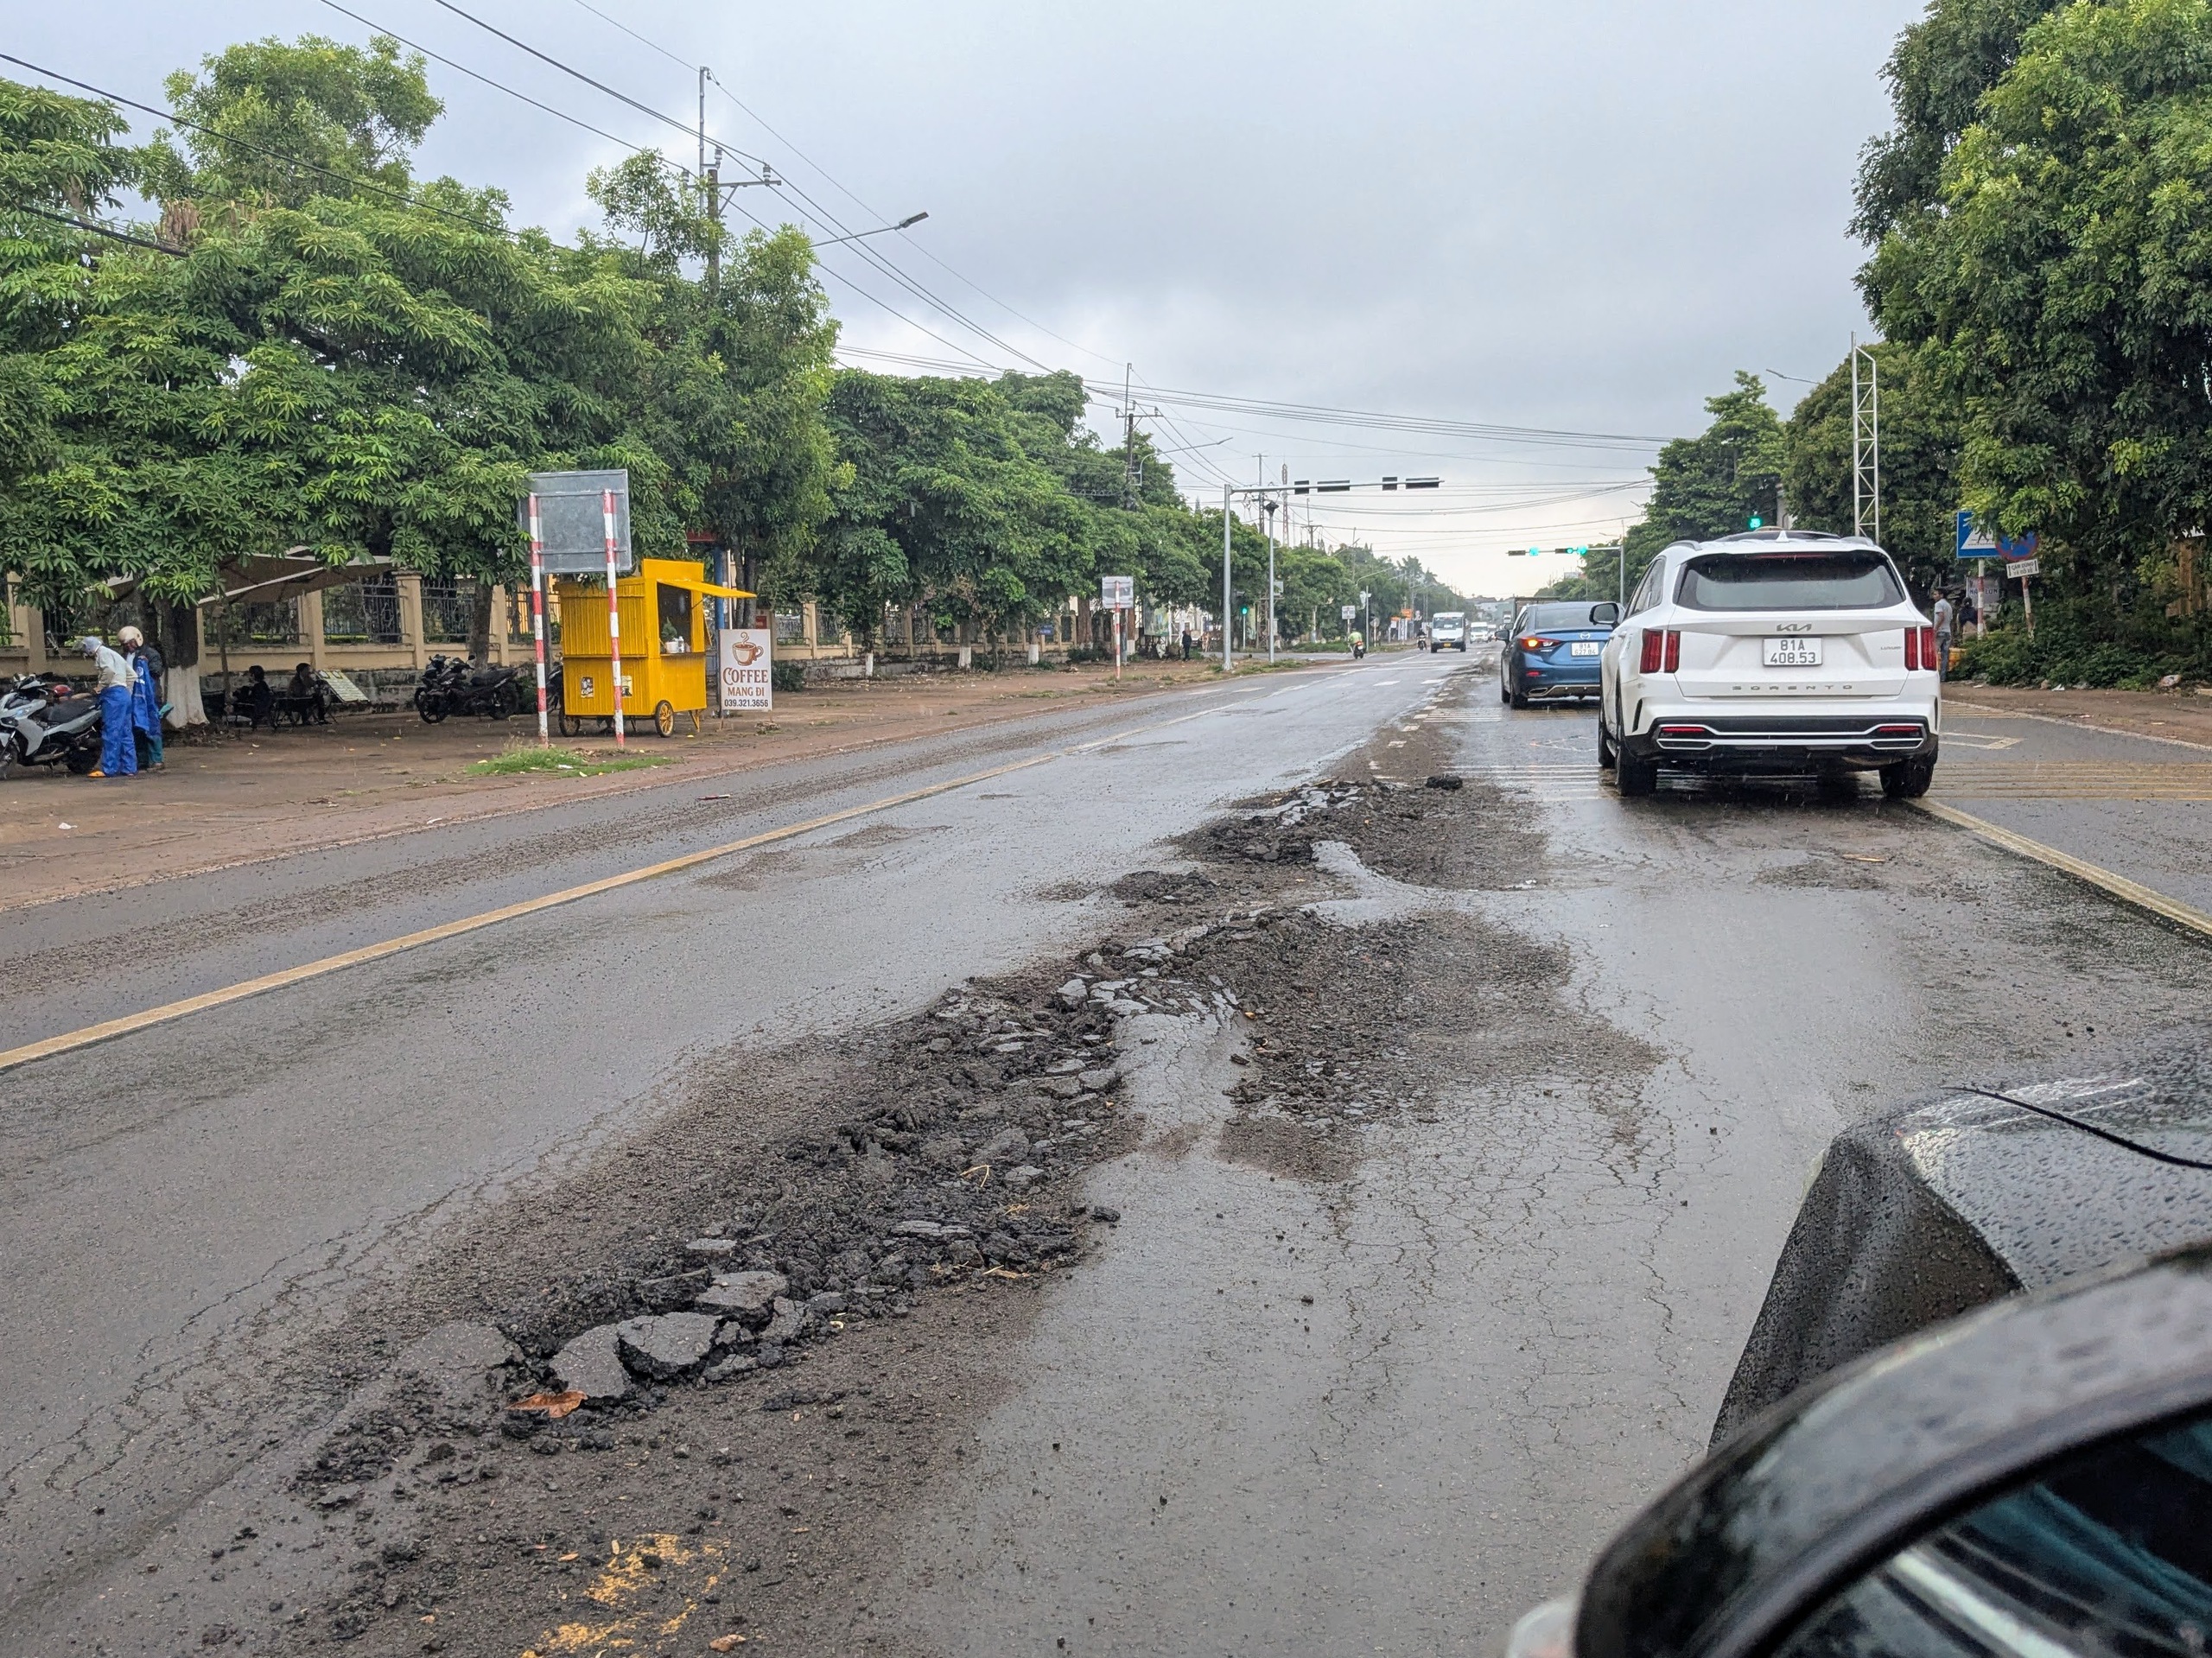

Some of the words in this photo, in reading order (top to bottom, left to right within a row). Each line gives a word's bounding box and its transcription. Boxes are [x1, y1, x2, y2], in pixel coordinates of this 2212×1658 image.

[1777, 623, 1812, 632] KIA
[1780, 638, 1805, 651] 81A
[1770, 651, 1816, 664] 408.53
[722, 667, 768, 685] COFFEE
[728, 687, 753, 696] MANG
[755, 686, 765, 696] ĐI
[724, 699, 768, 708] 039.321.3656
